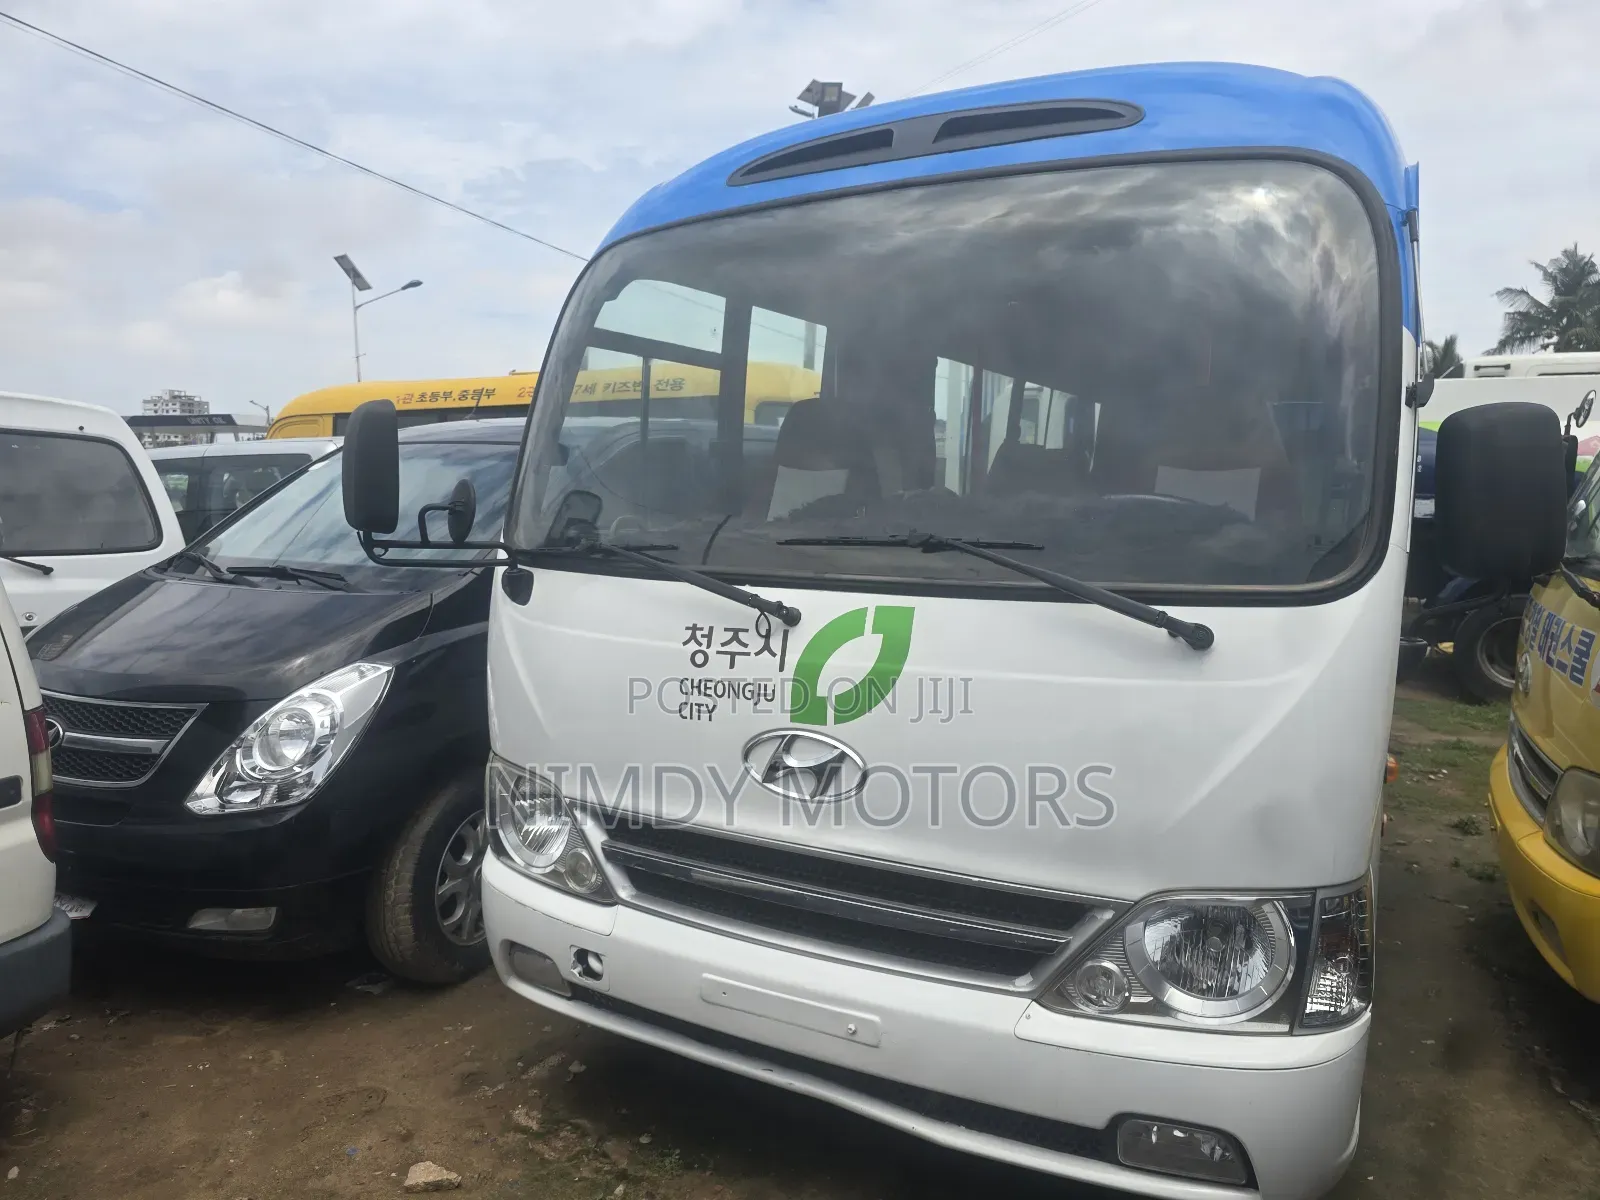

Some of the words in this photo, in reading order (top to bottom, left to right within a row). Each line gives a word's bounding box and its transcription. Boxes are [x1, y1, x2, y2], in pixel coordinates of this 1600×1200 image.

[681, 622, 791, 673] 청주시
[678, 677, 777, 706] CHEONGJU
[678, 701, 718, 722] CITY
